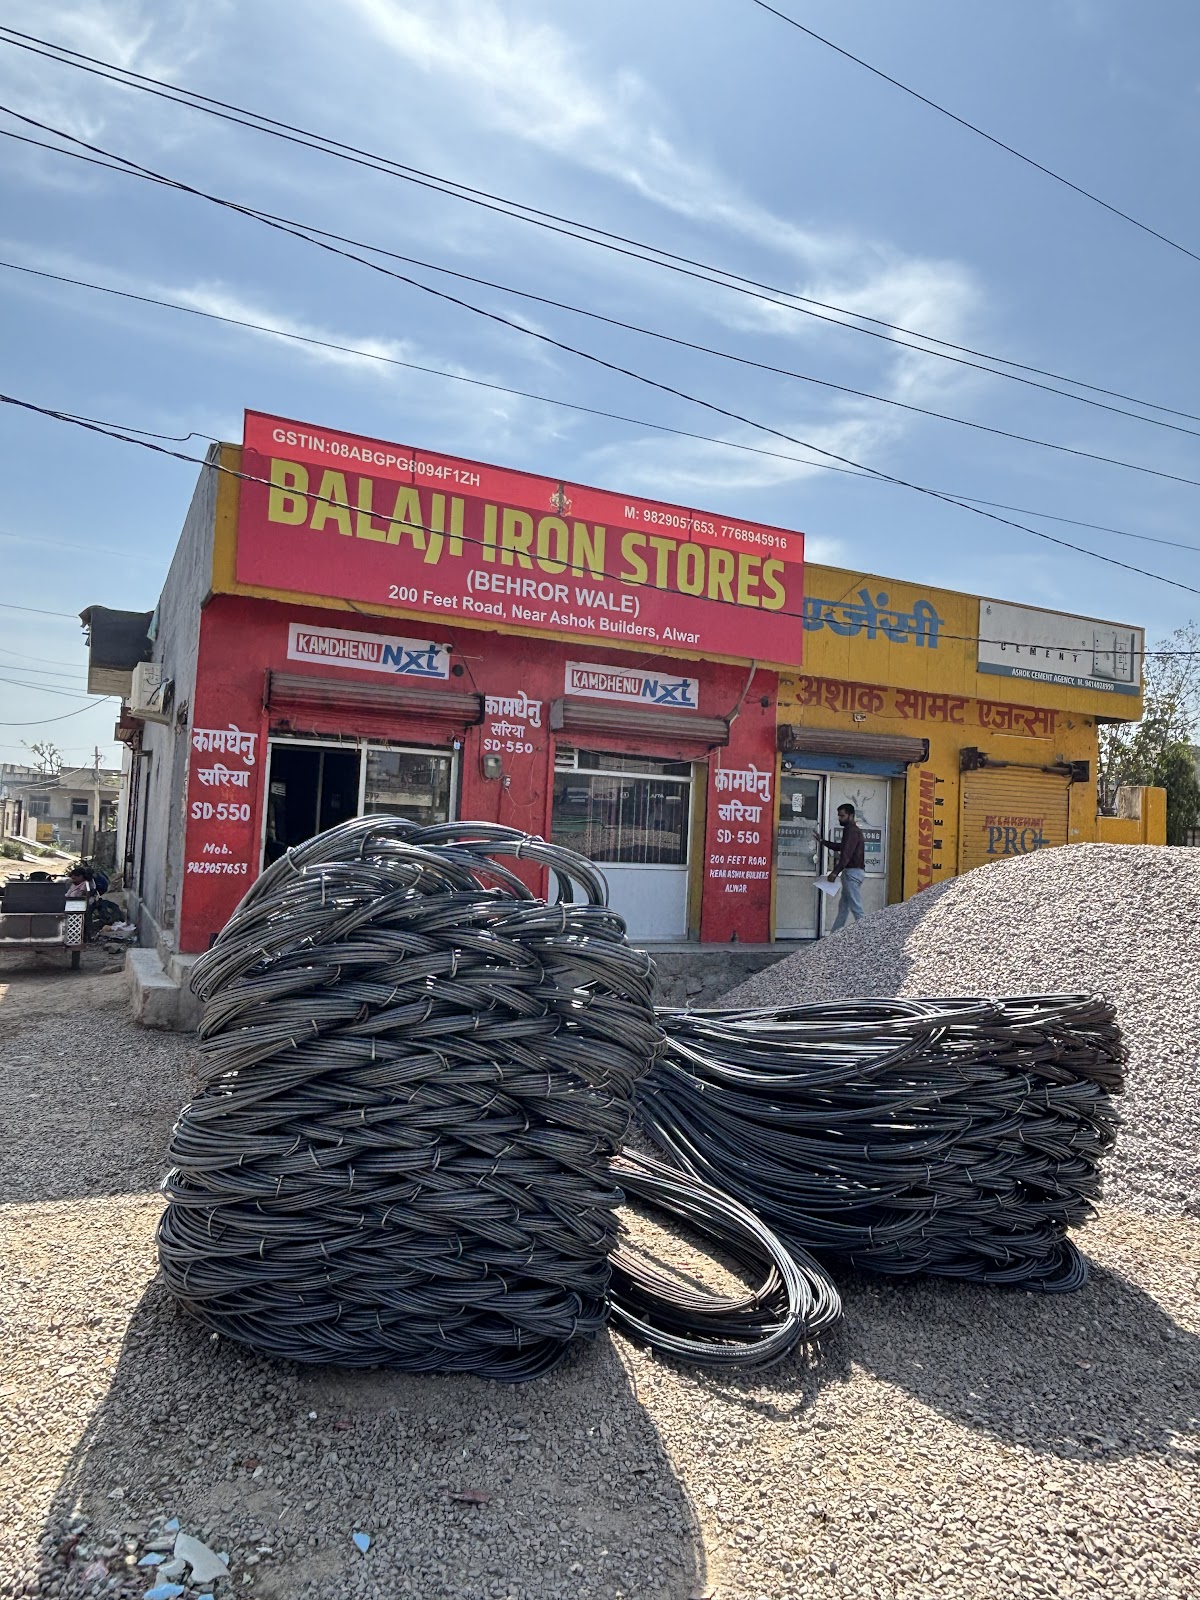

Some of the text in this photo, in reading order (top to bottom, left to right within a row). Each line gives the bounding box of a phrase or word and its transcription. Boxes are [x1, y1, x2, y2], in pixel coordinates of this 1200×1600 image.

[272, 428, 481, 487] GSTIN:08ABGPG8094F1ZH
[268, 457, 786, 610] BALAJI IRON STORES
[624, 505, 787, 549] M: 9829057653, 7768945916
[467, 570, 640, 618] (BEHROR WALE)
[389, 585, 700, 644] 200 Feet Road, Near Ashok Builders, Alwar
[298, 634, 378, 662] KAMDHENU
[573, 671, 639, 694] KAMDHENU
[1012, 668, 1031, 678] ASHOK
[1031, 671, 1053, 682] CEMENT
[485, 690, 543, 728] कामधेनु
[192, 723, 258, 766] कामधेनु
[491, 720, 526, 738] सरिया
[197, 763, 251, 787] सरिया
[714, 763, 772, 802] कामधेनु
[718, 799, 762, 823] सरिया
[918, 770, 936, 877] LAKSHMI
[932, 777, 945, 870] EMENT
[203, 843, 233, 855] Mob.
[710, 854, 767, 866] 200 FEET ROAD
[187, 862, 248, 875] 9829057653
[725, 884, 747, 893] ALWAR
